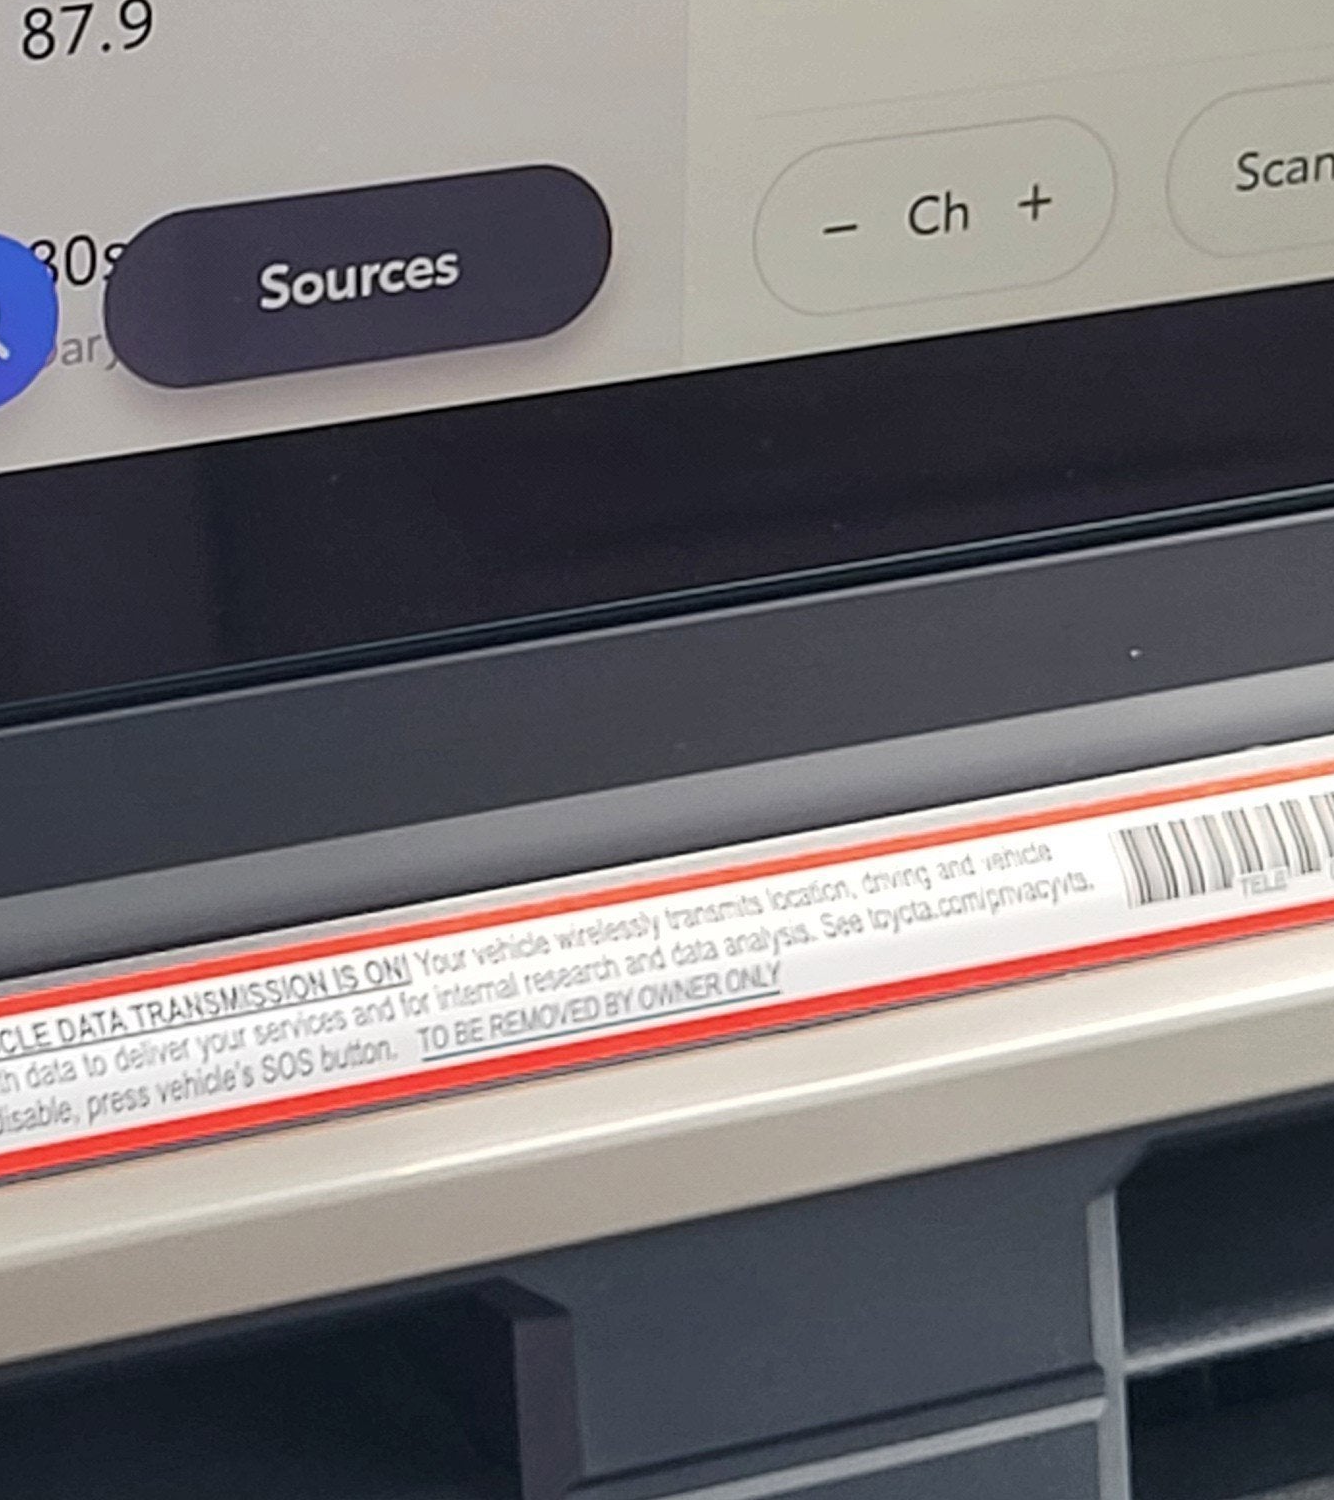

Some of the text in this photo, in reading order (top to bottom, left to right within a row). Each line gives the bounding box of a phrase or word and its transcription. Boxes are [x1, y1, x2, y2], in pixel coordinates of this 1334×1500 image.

[908, 192, 970, 240] Ch
[258, 246, 459, 310] Sources
[56, 1008, 128, 1045] DATA
[132, 971, 327, 1028] TRANSMISSION
[334, 965, 359, 992] IS
[414, 948, 466, 976] Your
[473, 930, 551, 966] vehicle
[554, 909, 660, 950] wirelessly
[665, 894, 763, 930] transmits
[766, 878, 857, 910] location,
[862, 864, 932, 894] driving
[937, 853, 976, 880] and
[983, 841, 1054, 871] vehicle
[26, 1057, 77, 1089] data
[82, 1050, 108, 1077] to
[116, 1035, 191, 1071] deliver
[198, 1027, 246, 1060] your
[255, 1007, 348, 1049] services
[354, 994, 395, 1026] and
[402, 989, 430, 1017] for
[433, 973, 519, 1009] internal
[524, 955, 620, 992] research
[625, 945, 666, 975] and
[671, 937, 719, 966] data
[723, 920, 819, 957] analysis.
[820, 911, 864, 939] See
[416, 960, 781, 1054] TO BE REMOVED BY OWNER ONLY
[86, 1081, 151, 1127] press
[156, 1059, 255, 1100] vehicle's
[261, 1046, 315, 1084] SOS
[320, 1037, 398, 1073] button.
